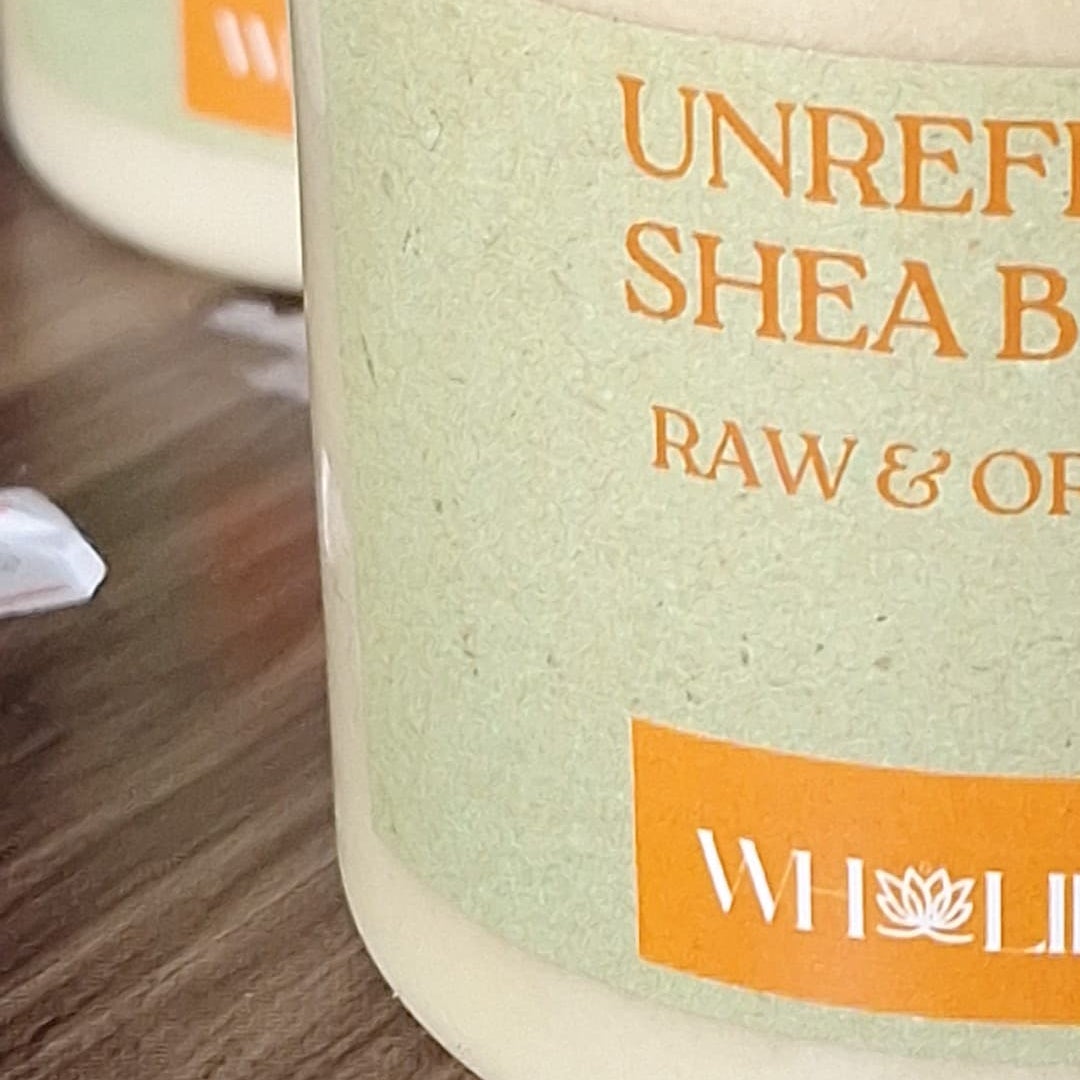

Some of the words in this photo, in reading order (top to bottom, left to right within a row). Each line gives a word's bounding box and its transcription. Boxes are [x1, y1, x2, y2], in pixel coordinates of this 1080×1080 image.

[624, 222, 968, 360] SHEA
[651, 405, 858, 501] RAW
[877, 444, 951, 509] &
